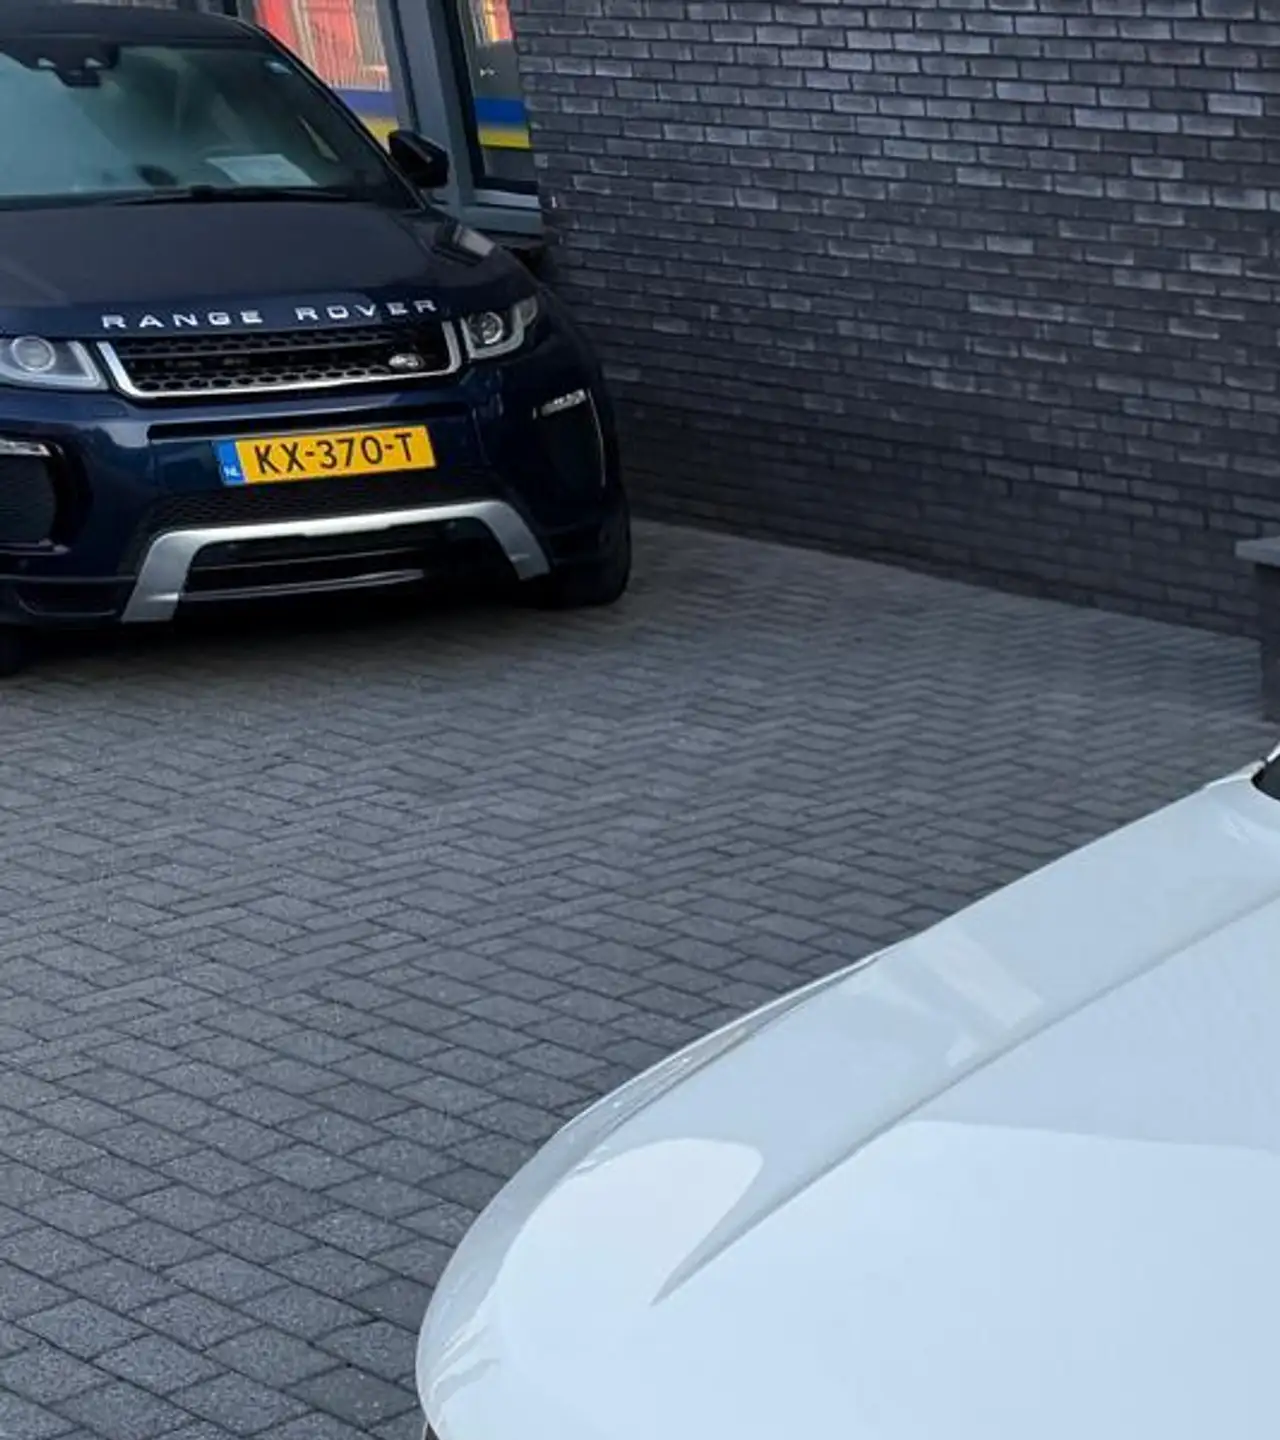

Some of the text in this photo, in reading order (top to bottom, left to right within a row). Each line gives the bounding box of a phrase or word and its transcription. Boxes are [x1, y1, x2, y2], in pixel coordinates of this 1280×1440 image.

[101, 299, 438, 330] RANGE ROVER
[253, 431, 413, 476] KX-370-T
